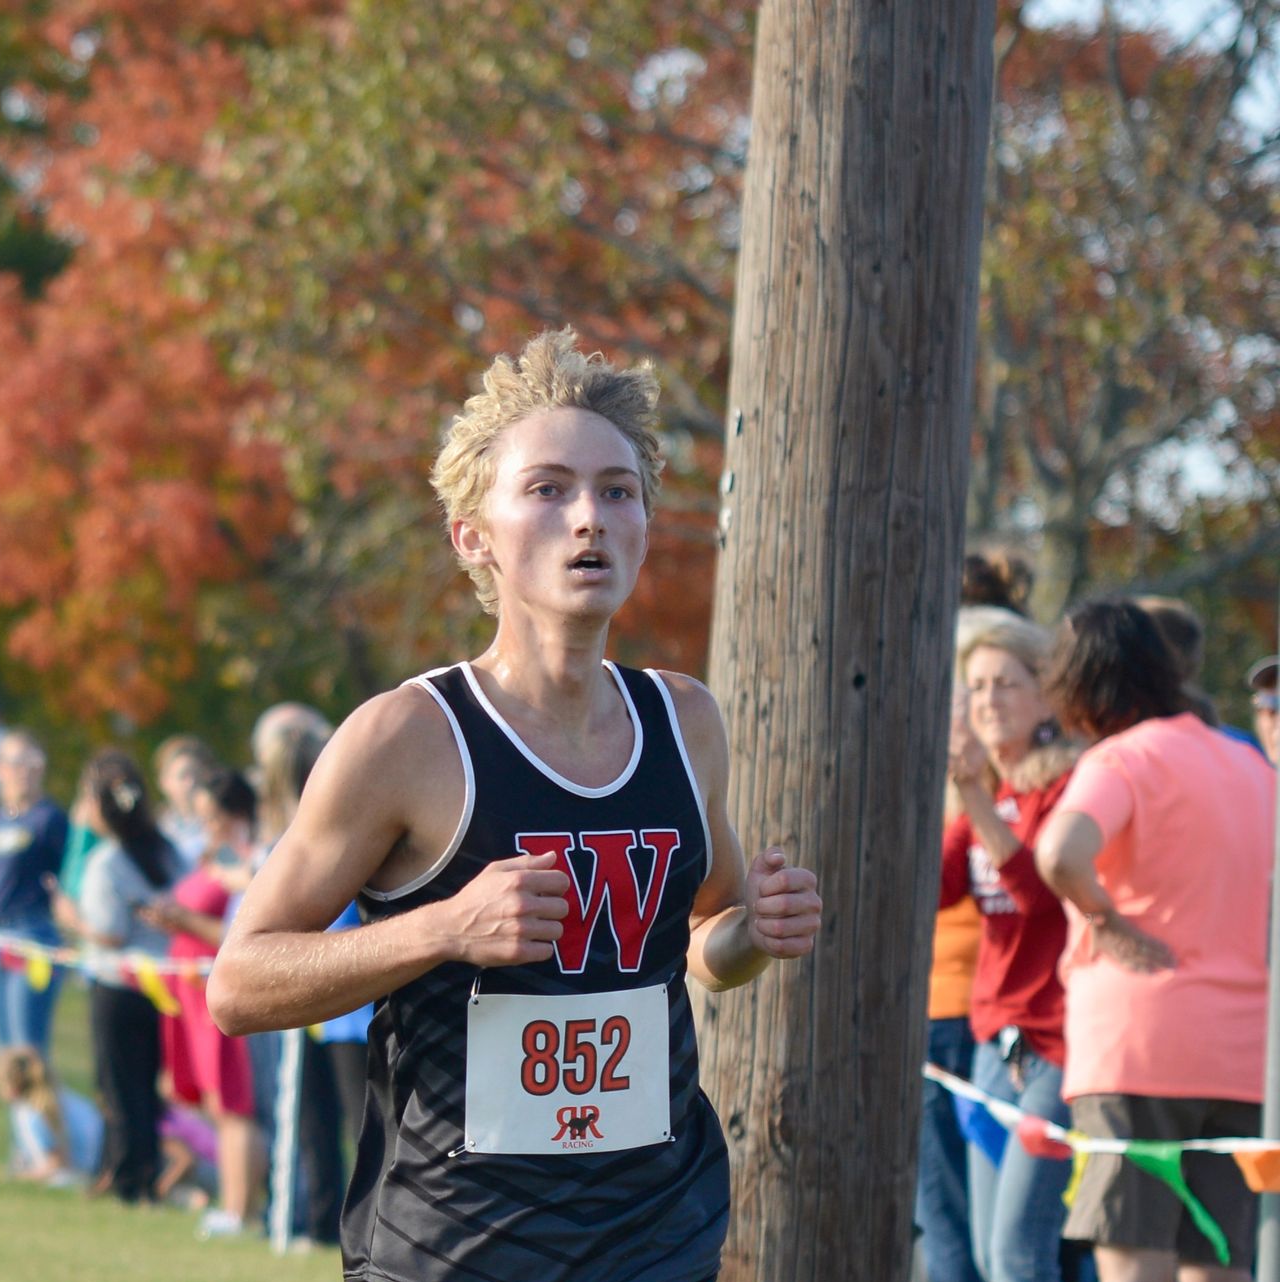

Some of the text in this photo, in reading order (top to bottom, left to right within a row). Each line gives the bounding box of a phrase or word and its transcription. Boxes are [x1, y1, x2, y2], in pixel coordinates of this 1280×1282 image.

[516, 829, 681, 974] W
[521, 1015, 631, 1096] 852
[561, 1140, 594, 1149] RACING
